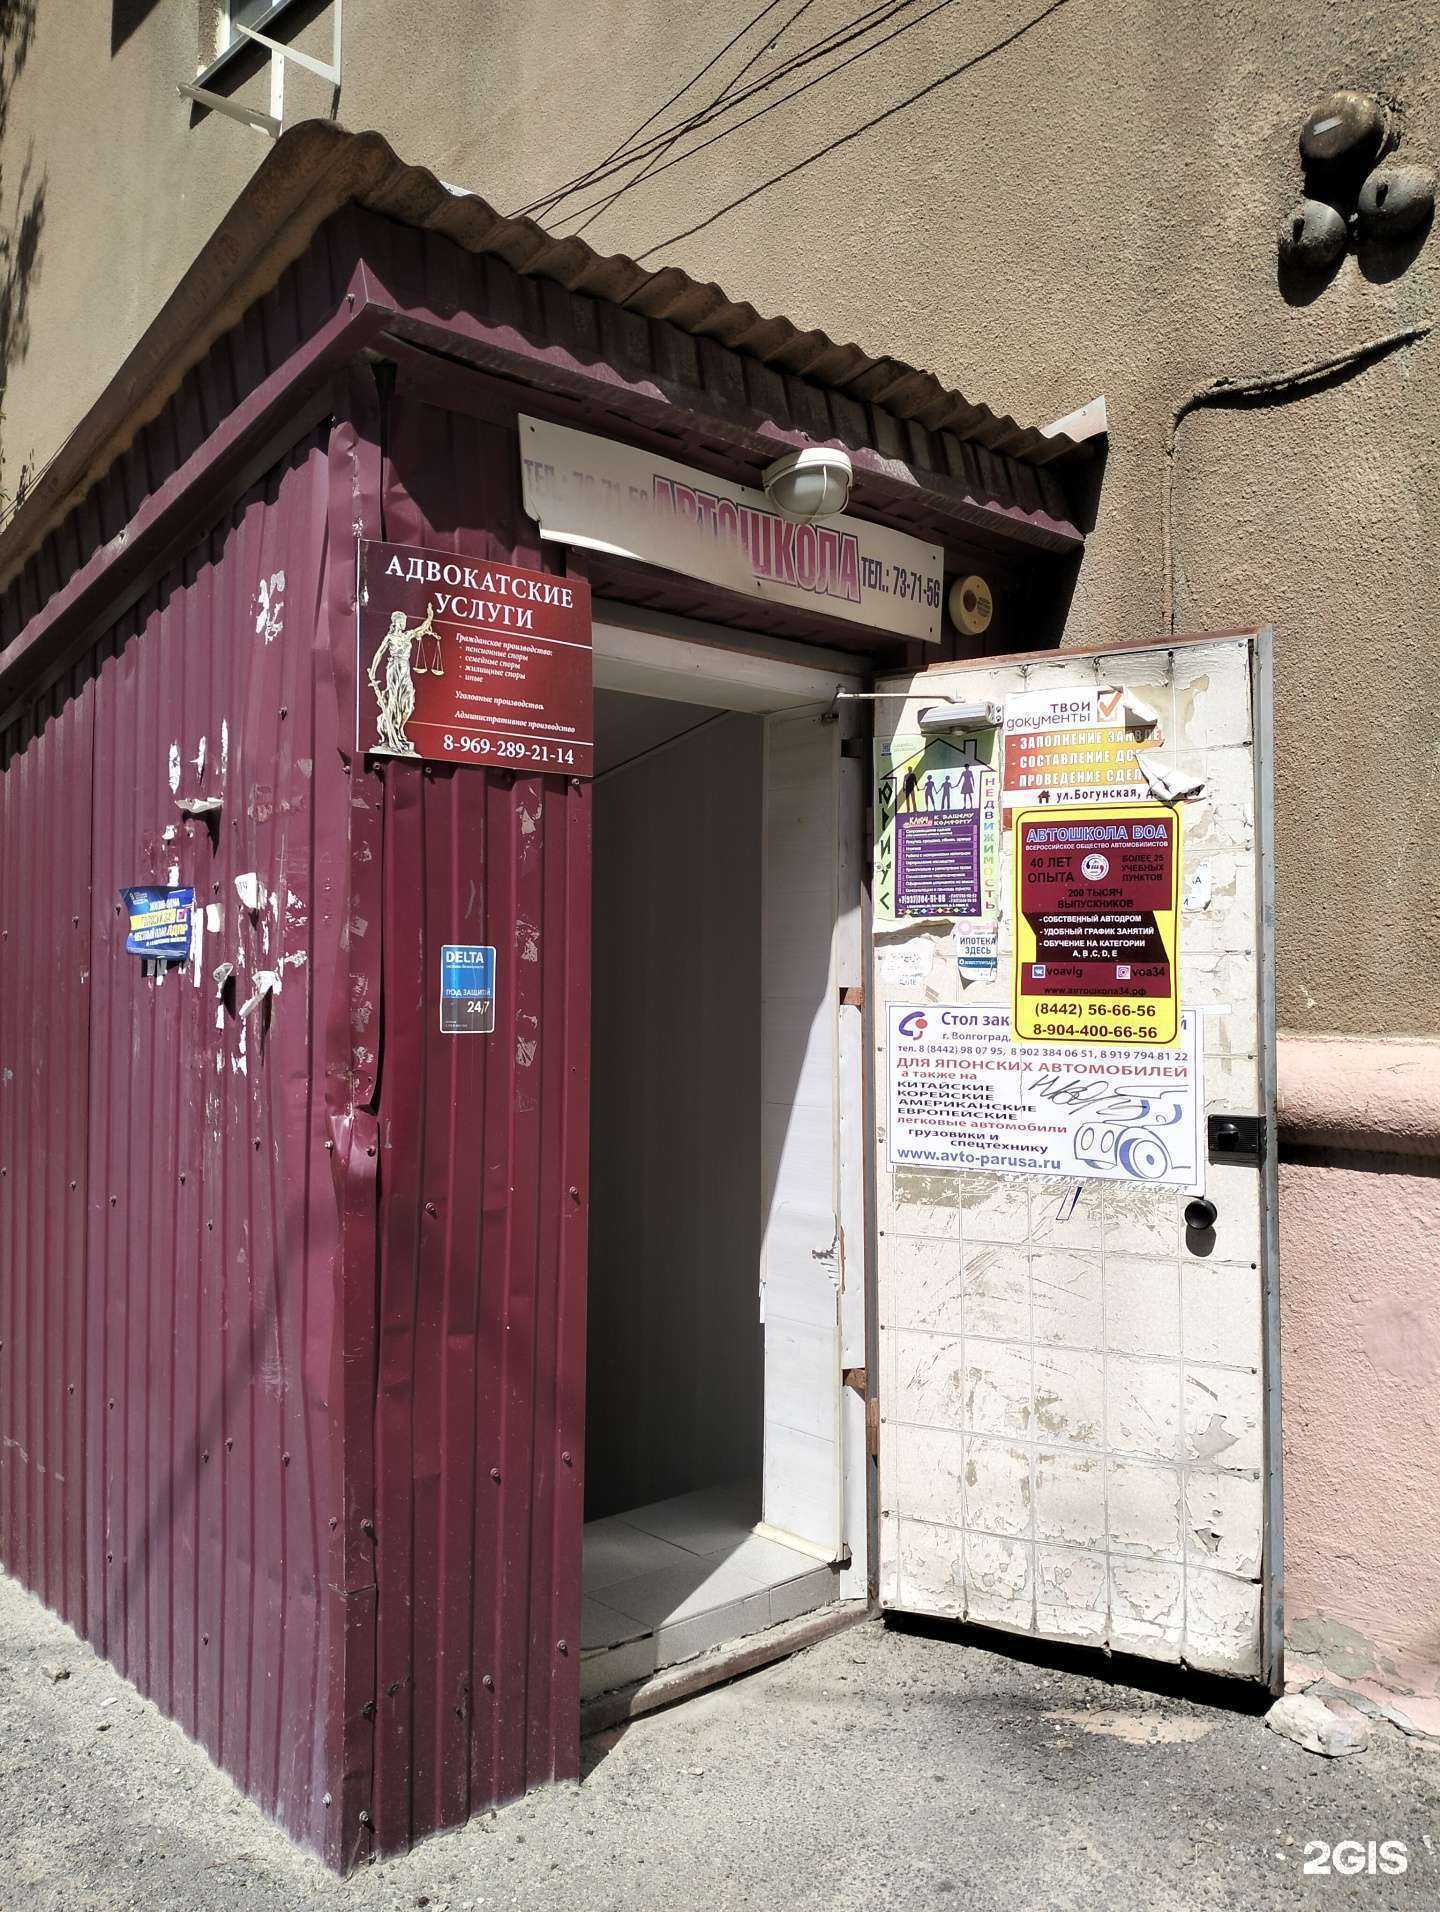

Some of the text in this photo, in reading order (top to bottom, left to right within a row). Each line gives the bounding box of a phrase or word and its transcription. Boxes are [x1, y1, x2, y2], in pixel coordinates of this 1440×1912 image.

[385, 555, 573, 608] АДВОКАТСКИЕ
[893, 565, 940, 609] 73-71-56
[434, 592, 533, 630] УСЛУГИ
[1006, 713, 1090, 731] документы
[1019, 731, 1103, 749] ЗАПОЛНЕНИЕ
[443, 734, 574, 764] 8-969-289-21-14
[1019, 750, 1110, 768] СОСТАВЛЕНИЕ
[1019, 768, 1143, 787] ПРОВЕДЕНИЕ СДЕЛ
[1026, 824, 1167, 843] АВТОШКОЛА ВОА
[1026, 843, 1075, 851] ВСЕРОССИЙСКОЕ
[1076, 842, 1109, 850] ОБЩЕСТВО
[1030, 857, 1072, 868] 40 ЛЕТ
[1121, 864, 1164, 872] УЧЕБНЫХ
[1027, 873, 1075, 883] ОПЫТА
[1122, 873, 1163, 881] ПУНКТОВ
[1068, 888, 1123, 897] 200 ТЫСЯЧ
[1058, 900, 1134, 909] ВЫПУСКНИКОВ
[1100, 915, 1141, 923] АВТОДРОМ
[1117, 927, 1154, 935] ЗАНЯТИЙ
[960, 937, 997, 945] ИПОТЕКА
[446, 951, 484, 963] DELTA
[965, 946, 991, 955] ЗДЕСЬ
[1132, 967, 1165, 977] voa34
[467, 1001, 490, 1015] 24/7
[1035, 1003, 1156, 1017] (8442) 56-66-56
[942, 1012, 1012, 1026] Стол зак
[1033, 1024, 1157, 1038] 8-904-400-66-56
[927, 1045, 958, 1054] (8442)
[975, 1047, 988, 1055] 07
[990, 1047, 1006, 1056] 95,
[1011, 1048, 1017, 1056] 8
[1020, 1048, 1038, 1056] 902
[1043, 1048, 1062, 1056] 384
[1065, 1049, 1078, 1057] 06
[1110, 1051, 1130, 1059] 919
[1134, 1052, 1154, 1060] 794
[1157, 1052, 1170, 1060] 81
[1175, 1053, 1188, 1061] 22
[897, 1058, 1187, 1077] ДЛЯ ЯПОНСКИХ АВТОМОБИЛЕЙ
[914, 1071, 956, 1079] также
[898, 1081, 995, 1092] КИТАЙСКИЕ
[898, 1090, 995, 1101] КОРЕЙСКИЕ
[899, 1099, 1037, 1112] АМЕРИКАНСКИЕ
[898, 1107, 1018, 1120] ЕВРОПЕЙСКИЕ
[897, 1117, 1067, 1133] легковые автомобили
[909, 1128, 985, 1140] грузовики
[951, 1140, 1048, 1155] спецтехнику
[898, 1149, 1061, 1169] www.avto-parusa.ru
